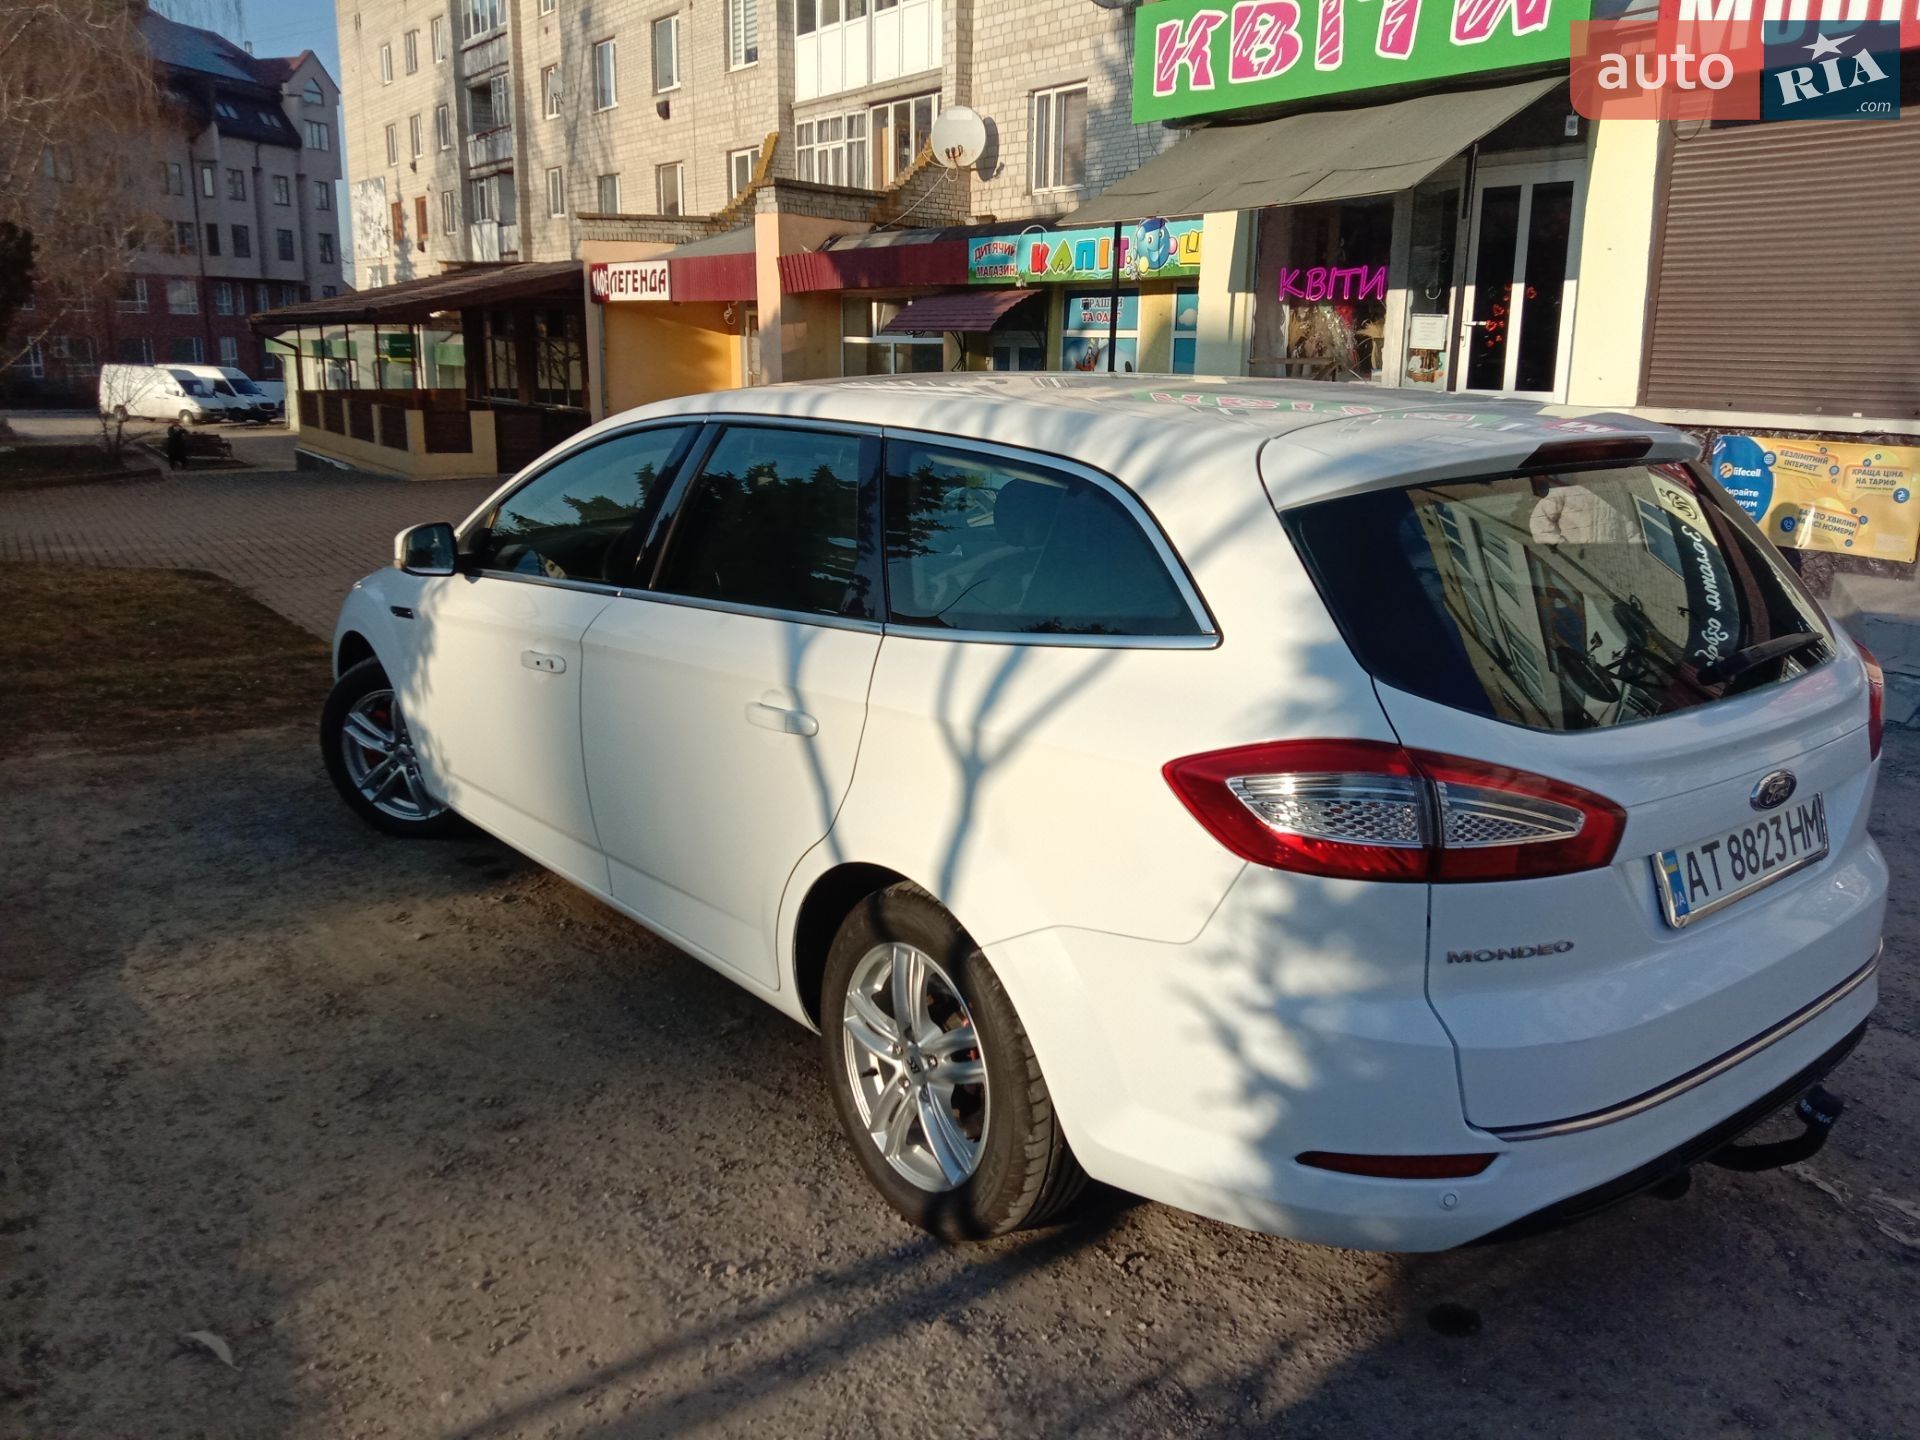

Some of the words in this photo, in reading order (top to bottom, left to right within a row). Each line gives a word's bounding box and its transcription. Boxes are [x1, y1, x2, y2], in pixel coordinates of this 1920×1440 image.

[976, 264, 1016, 278] МАГАЗИН
[609, 268, 667, 295] ЛЕГЕНДА
[1279, 265, 1386, 301] КВІТИ
[1082, 312, 1094, 322] ТА
[1780, 449, 1829, 465] БЕЗЛІМІТНИЙ
[1733, 467, 1762, 478] lifecell
[1784, 459, 1819, 472] ІНТЕРНЕТ
[1852, 468, 1881, 478] КРАЩА
[1883, 470, 1904, 479] ЦІНА
[1856, 477, 1867, 485] НА
[1869, 478, 1897, 486] ТАРИФ
[1827, 515, 1857, 529] ХВИЛИН
[1822, 524, 1855, 536] НОМЕРИ
[1686, 839, 1721, 903] AT
[1727, 815, 1787, 882] 8823
[1785, 799, 1822, 856] HM
[1446, 940, 1574, 964] MONDEO
